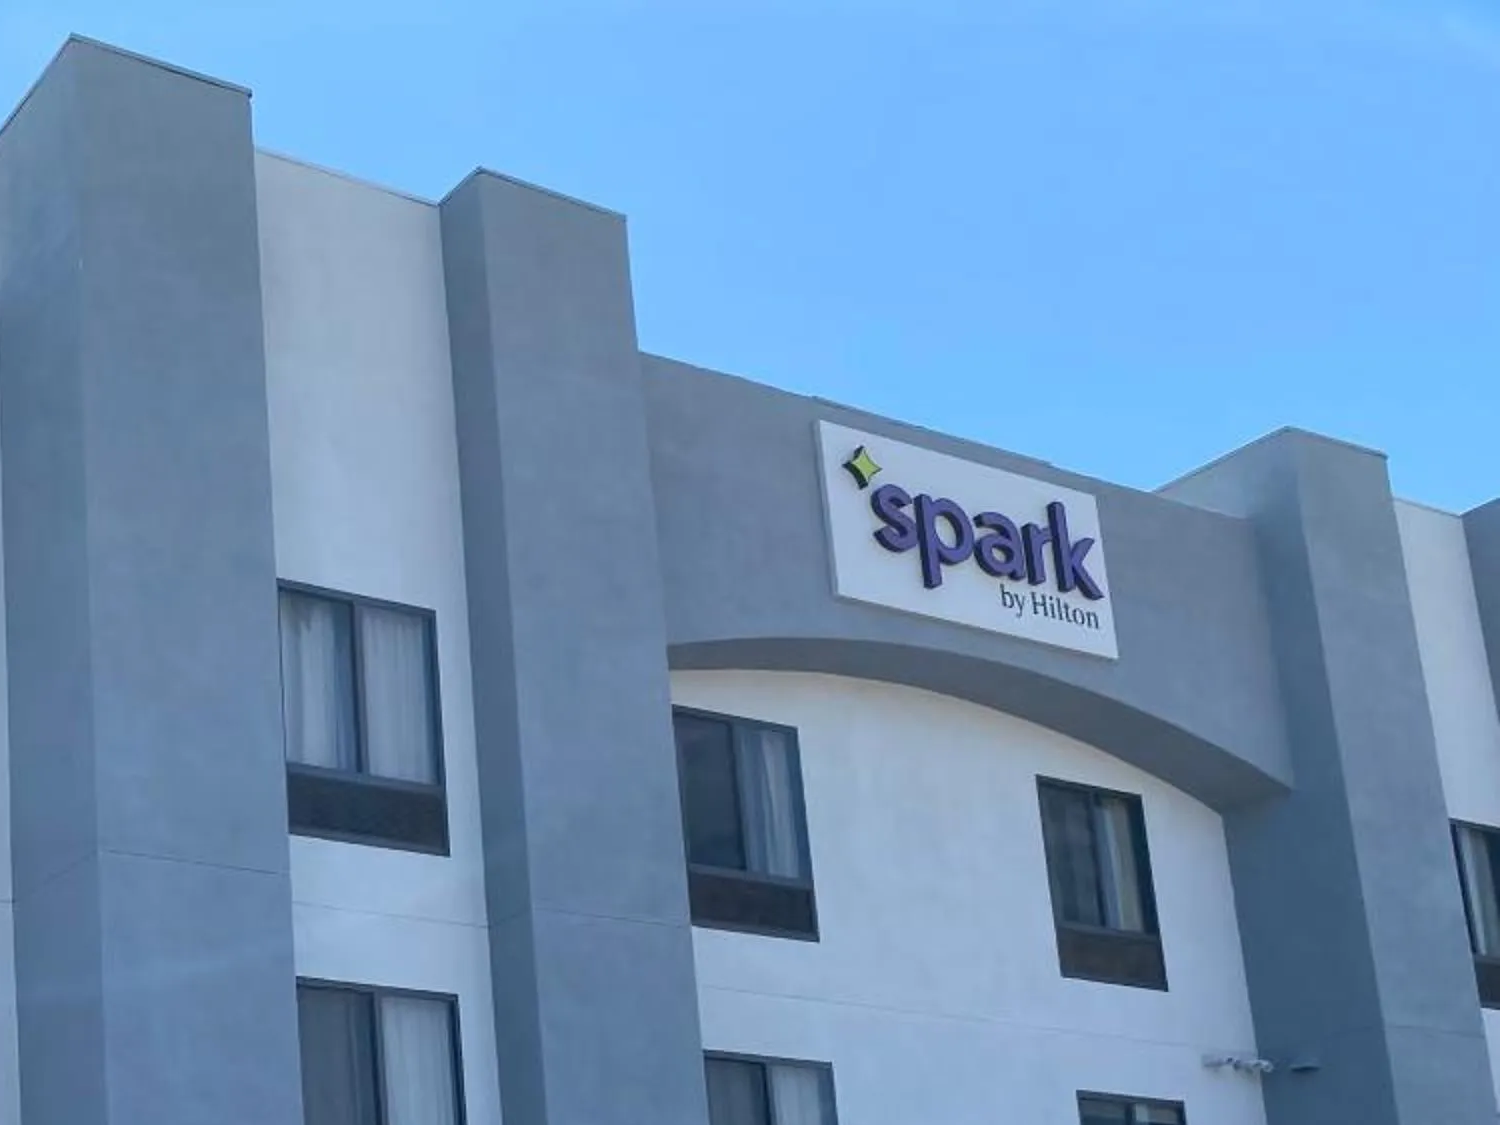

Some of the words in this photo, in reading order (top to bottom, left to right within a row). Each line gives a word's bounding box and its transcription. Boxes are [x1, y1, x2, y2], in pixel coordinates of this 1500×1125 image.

[871, 484, 1104, 600] spark
[1000, 584, 1027, 618] by
[1032, 594, 1100, 630] Hilton
